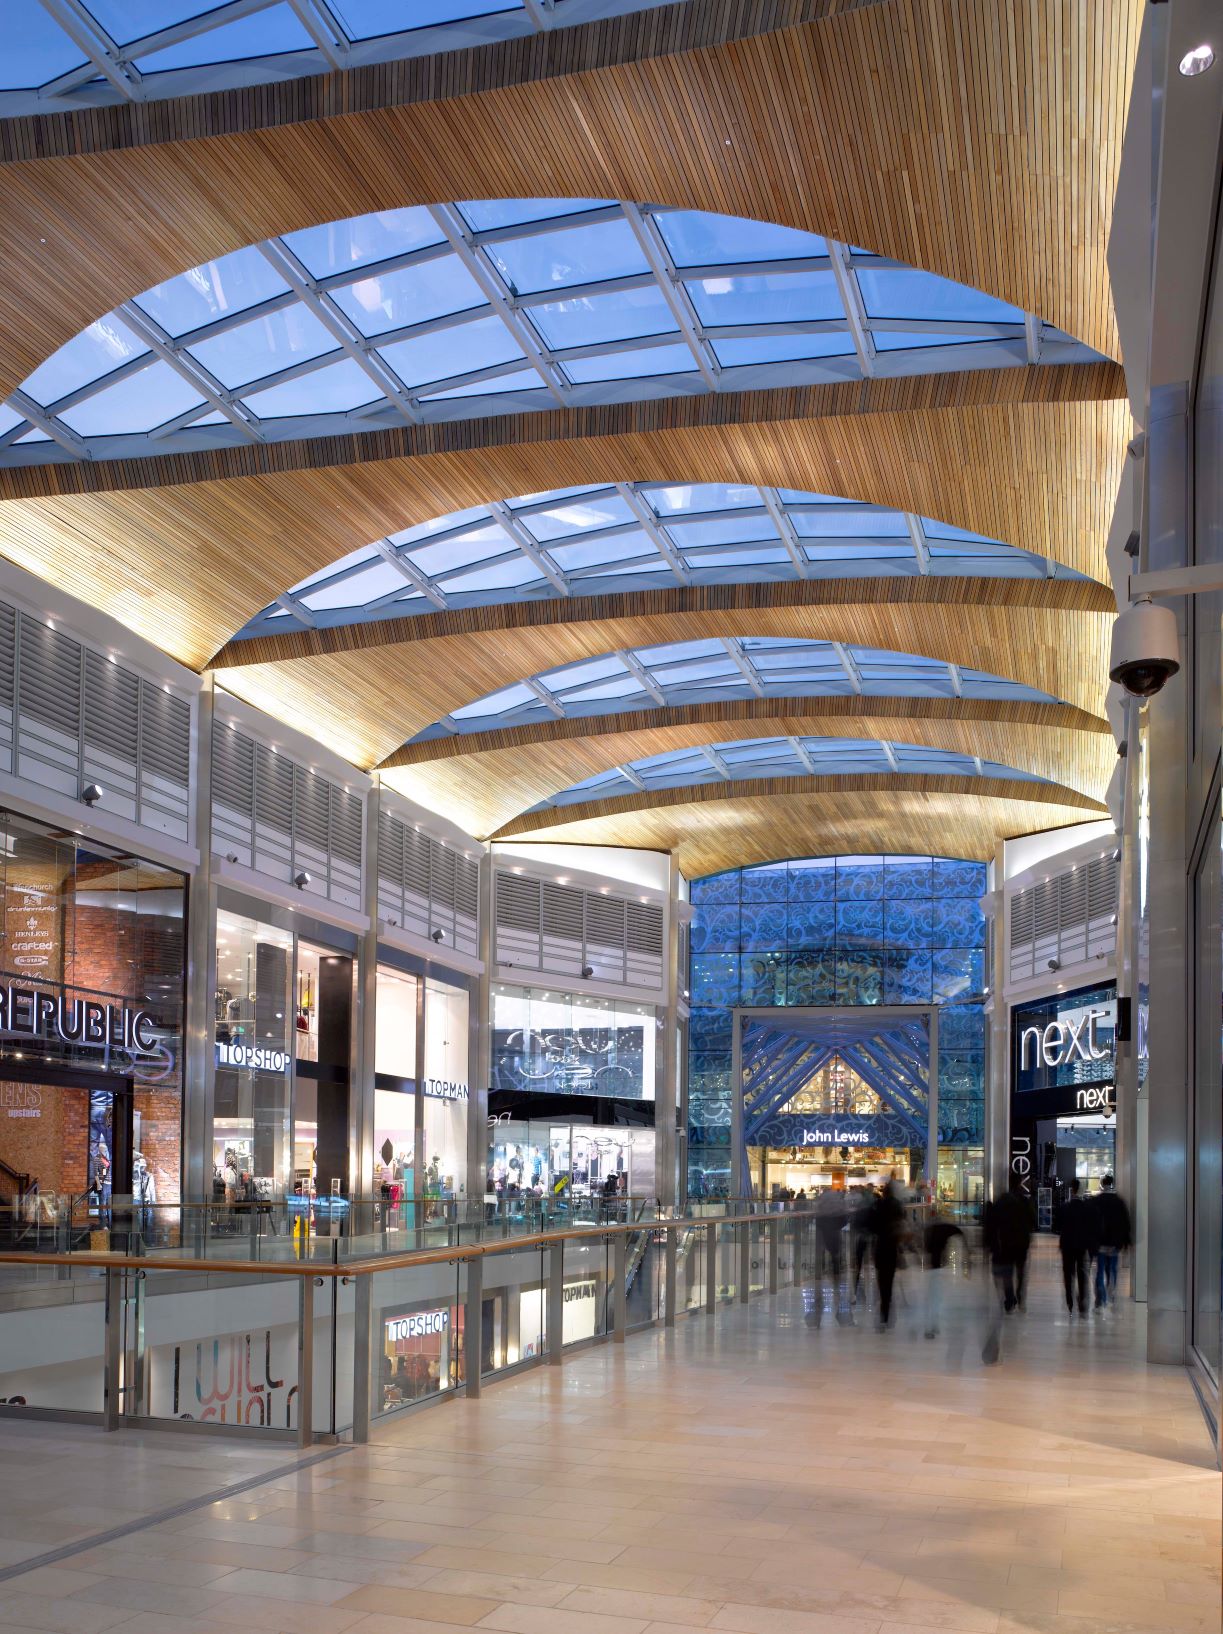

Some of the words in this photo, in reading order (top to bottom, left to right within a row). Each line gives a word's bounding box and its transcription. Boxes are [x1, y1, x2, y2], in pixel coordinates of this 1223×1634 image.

[12, 942, 53, 951] crafted
[1021, 1010, 1111, 1071] next
[222, 1044, 291, 1071] TOPSHOP
[428, 1078, 470, 1099] TOPMAN
[1077, 1085, 1114, 1109] next
[8, 1108, 41, 1118] upstairs
[802, 1129, 832, 1144] John
[834, 1129, 869, 1143] Lewis
[393, 1312, 449, 1340] TOPSHOP
